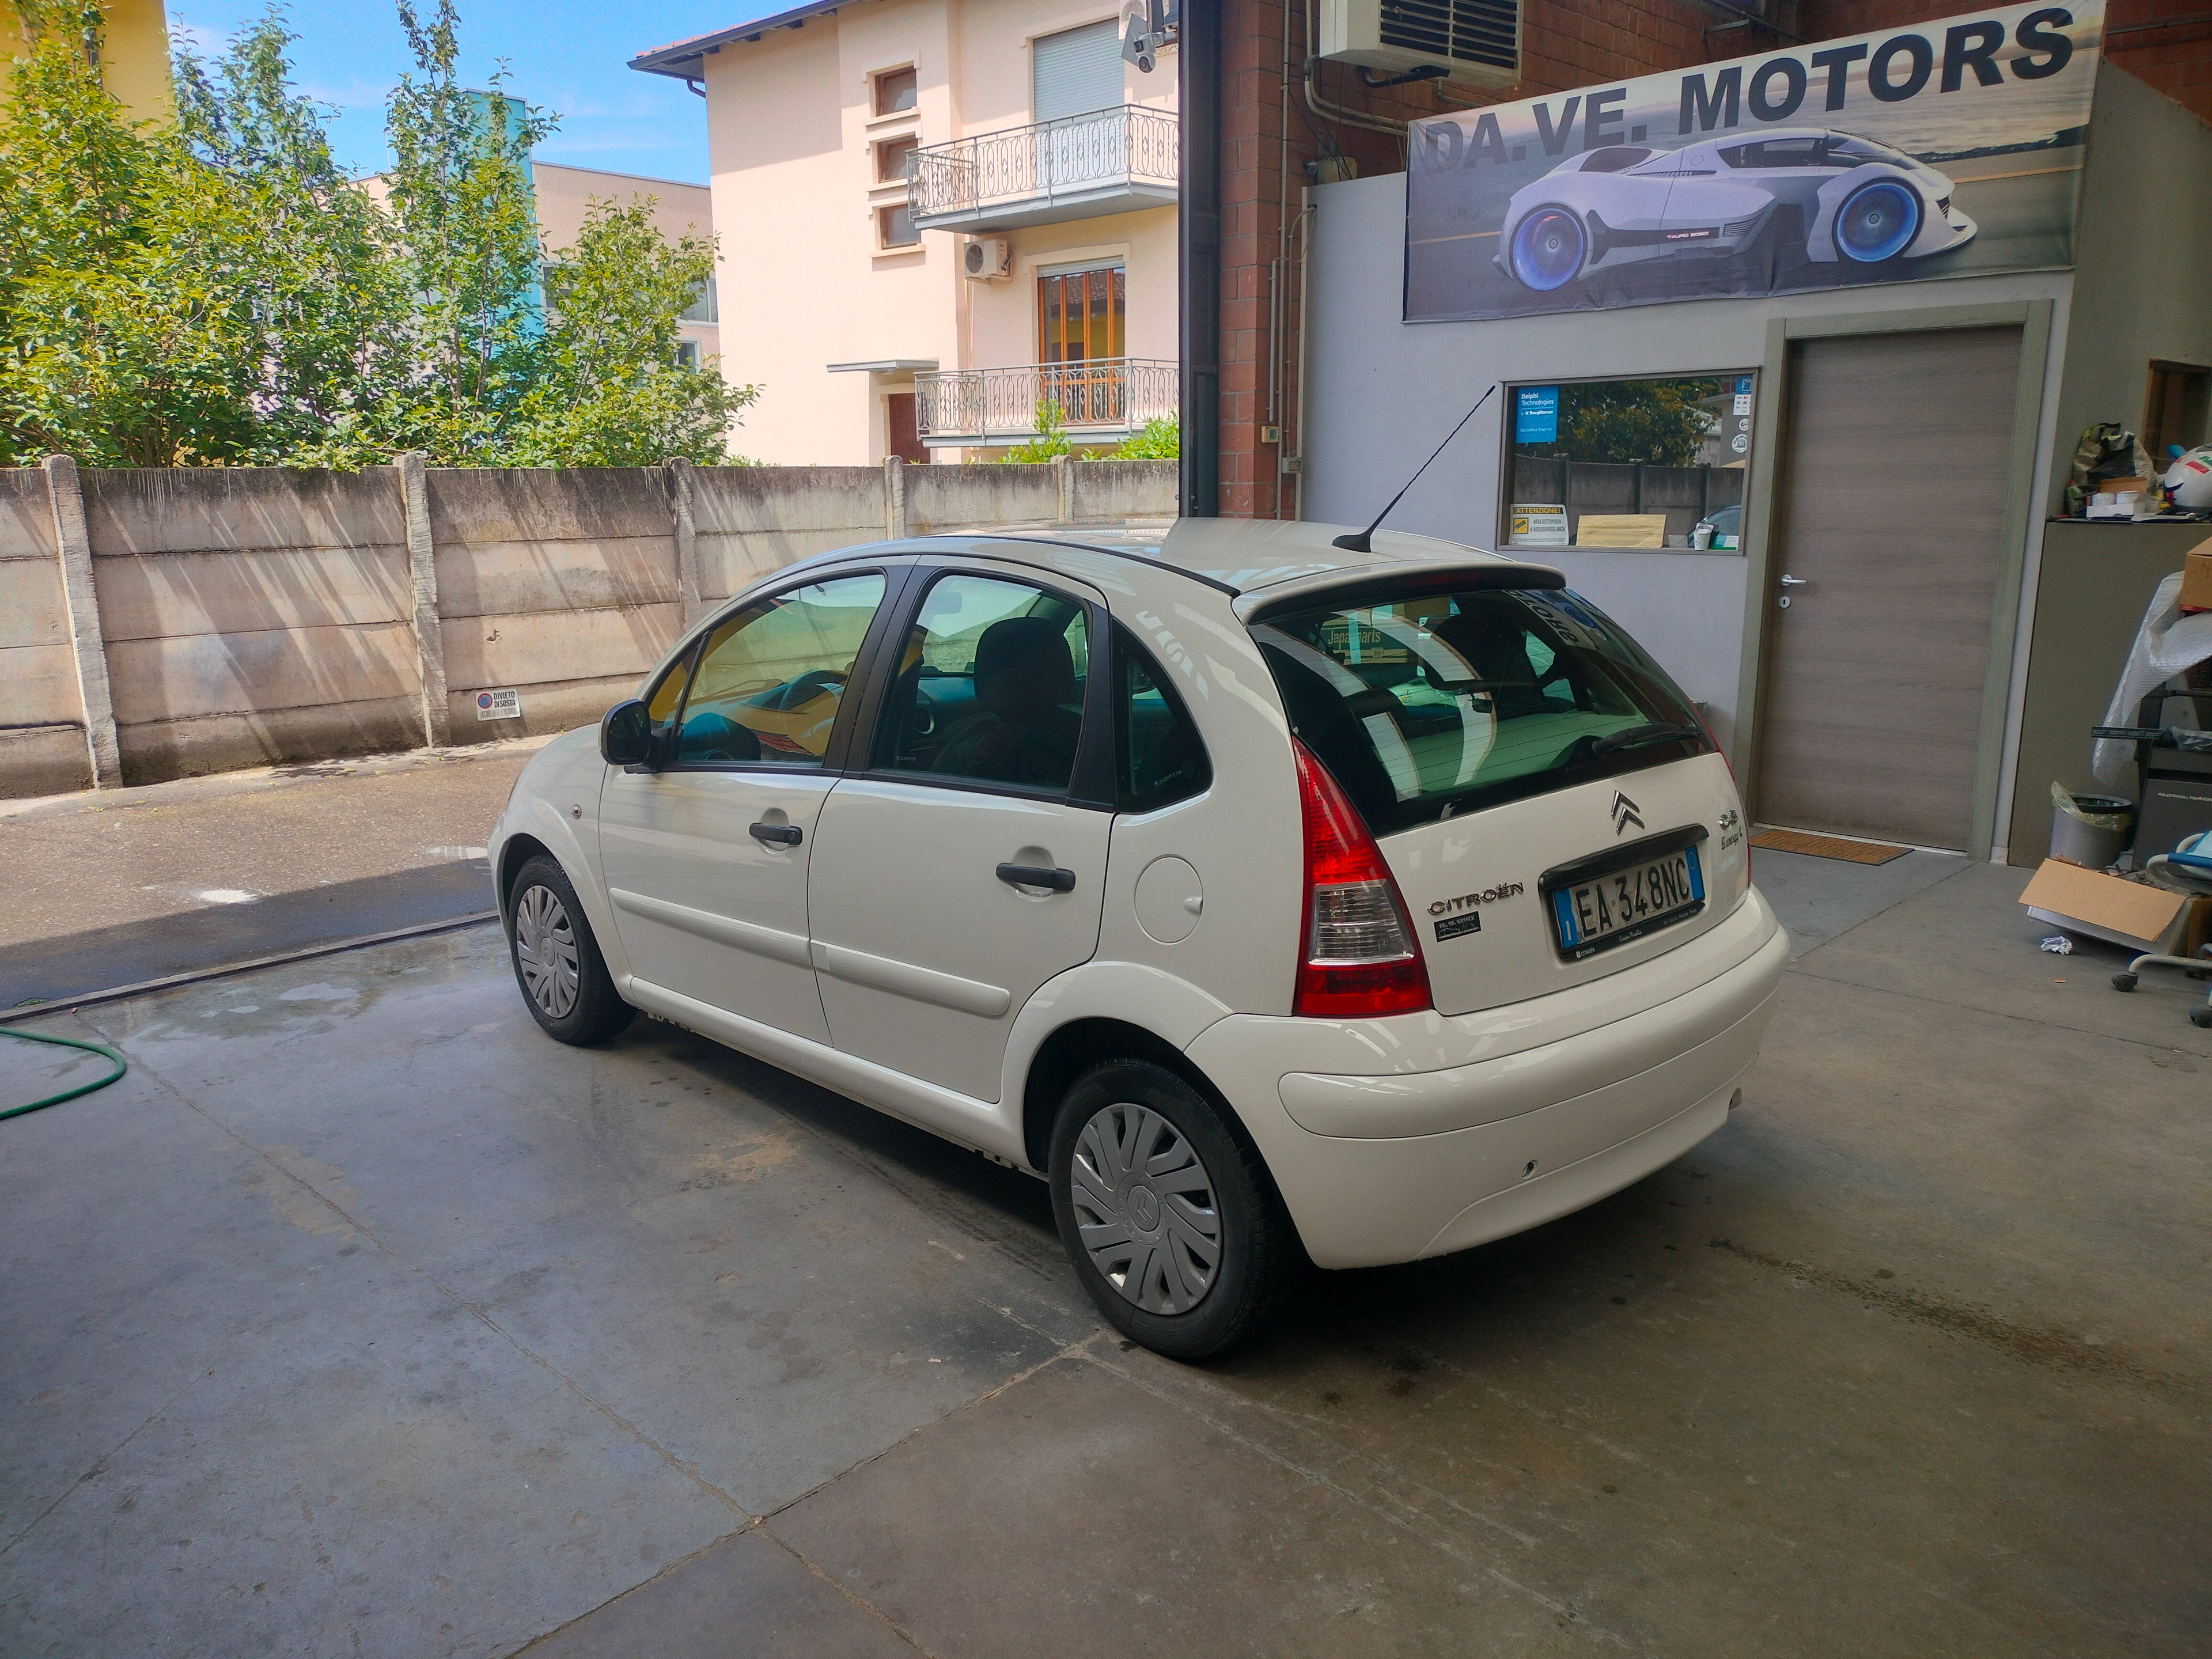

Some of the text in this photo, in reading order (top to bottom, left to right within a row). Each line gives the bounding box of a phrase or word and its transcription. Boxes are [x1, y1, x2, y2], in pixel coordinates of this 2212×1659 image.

[1424, 7, 2074, 174] DA.VE. MOTORS
[1328, 630, 1381, 650] Japaarts
[494, 691, 515, 700] DIVIETO
[1427, 882, 1524, 915] CITROËN
[1575, 884, 1613, 937] EA
[1615, 858, 1690, 922] 348NC
